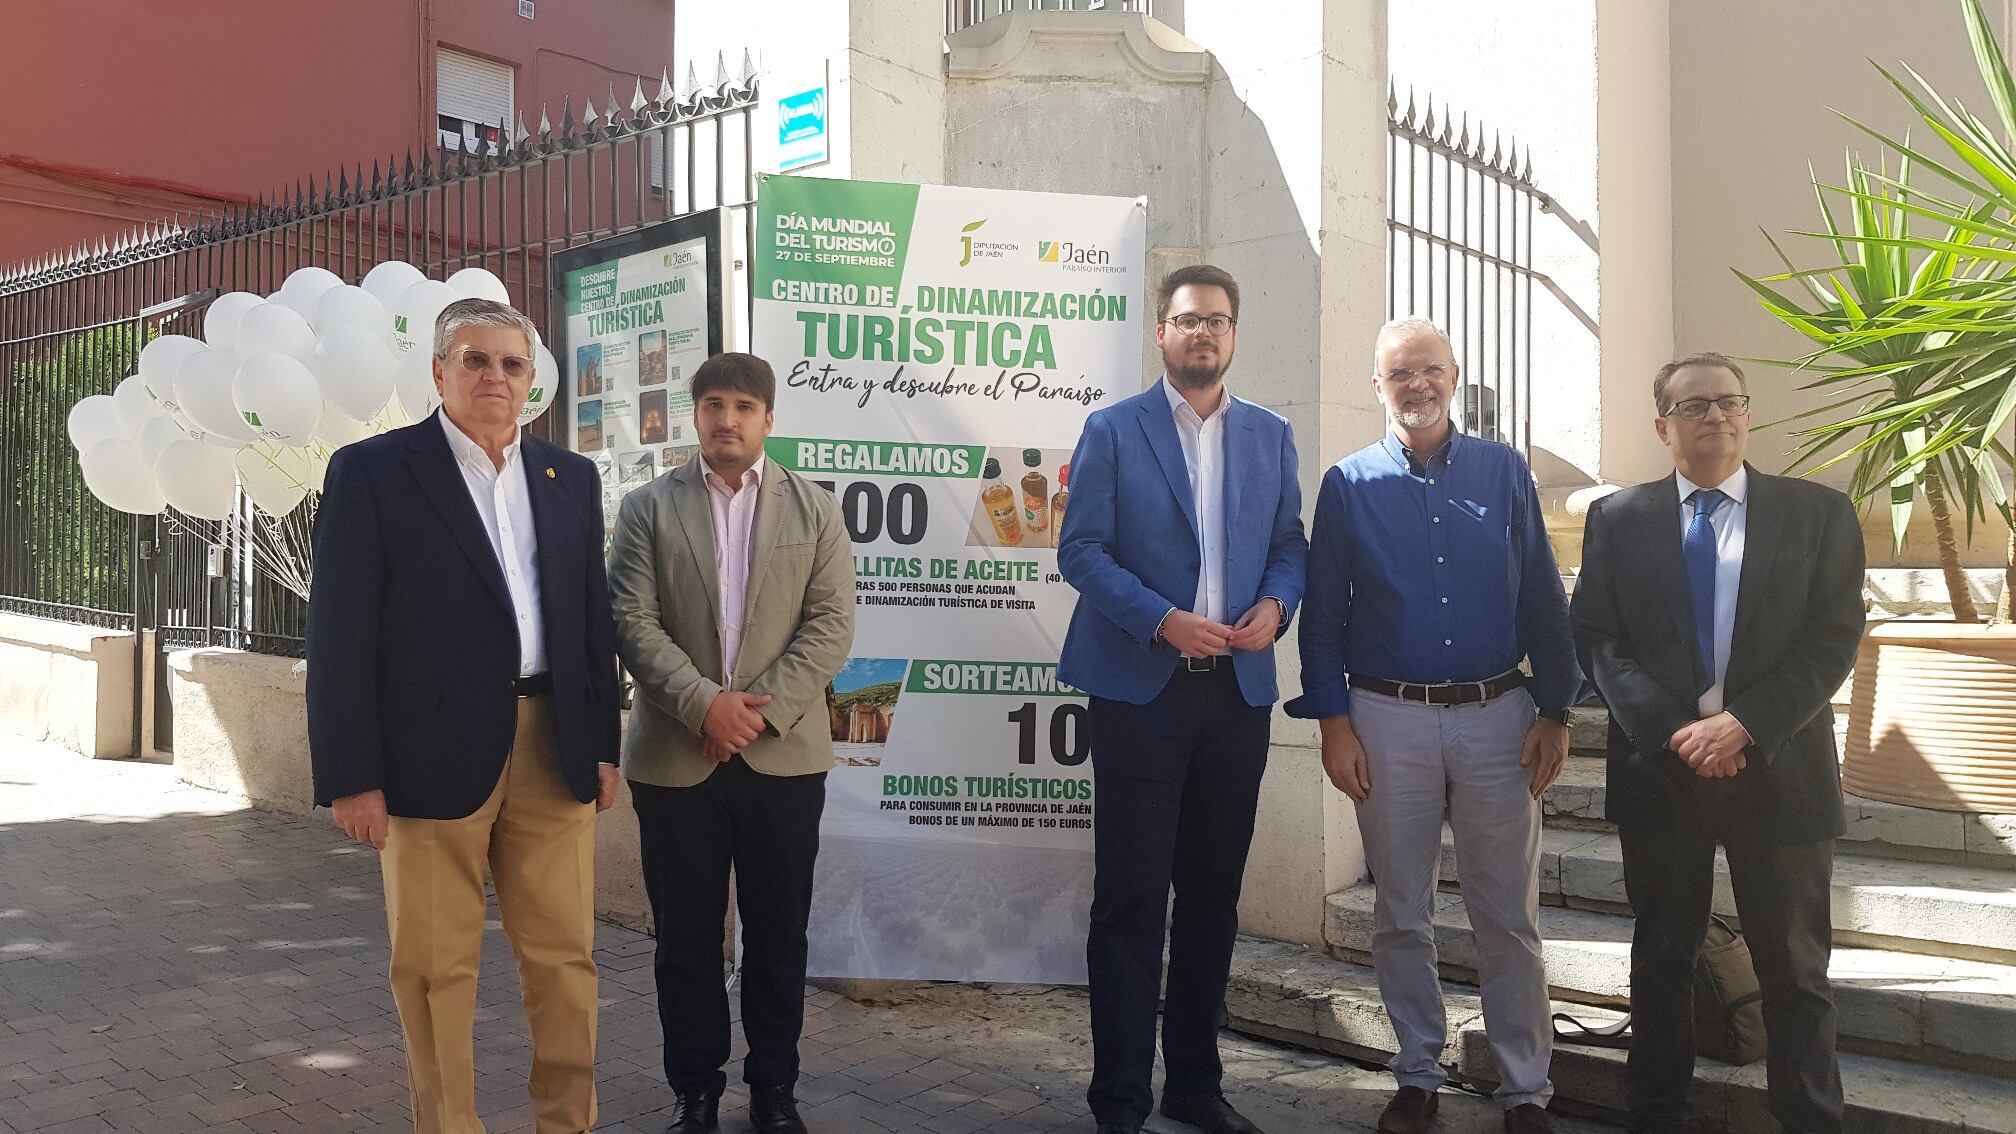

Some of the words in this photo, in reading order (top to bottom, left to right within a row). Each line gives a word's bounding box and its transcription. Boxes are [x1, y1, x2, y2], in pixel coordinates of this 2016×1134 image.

[776, 212, 809, 231] DÍA
[811, 216, 896, 237] MUNDIAL
[775, 232, 811, 249] DEL
[812, 234, 896, 256] TURISMO
[973, 242, 1019, 251] DIPUTACIÓN
[985, 250, 1004, 258] JAÉN
[1062, 242, 1109, 265] Jaén
[672, 250, 692, 265] Jaén
[776, 251, 791, 260] 27
[794, 251, 812, 262] DE
[815, 253, 895, 267] SEPTIEMBRE
[1062, 264, 1093, 273] PARAÍSO
[1093, 266, 1127, 274] INTERIOR
[580, 268, 616, 287] DESCUBRE
[580, 284, 611, 301] NUESTRO
[580, 299, 605, 313] CENTRO
[605, 296, 615, 308] DE
[620, 276, 686, 306] DINAMIZACIÓN
[772, 279, 859, 305] CENTRO
[865, 285, 894, 307] DE
[917, 284, 1127, 322] DINAMIZACIÓN
[587, 300, 664, 338] TURÍSTICA
[796, 305, 1057, 370] TURÍSTICA
[787, 360, 858, 393] Entra
[857, 381, 879, 408] y
[883, 364, 981, 399] descubre
[983, 369, 1007, 401] el
[1010, 372, 1106, 406] Paraíso
[797, 442, 970, 475] REGALAMOS
[812, 480, 929, 545] 00
[930, 558, 958, 579] DE
[963, 559, 1039, 581] ACEITE
[878, 582, 897, 592] 500
[900, 582, 952, 593] PERSONAS
[954, 584, 974, 595] QUE
[975, 585, 1016, 595] ACUDAN
[865, 595, 936, 607] DINAMIZACIÓN
[938, 596, 988, 608] TURÍSTICA
[990, 599, 1004, 609] DE
[1005, 600, 1036, 610] VISITA
[923, 663, 1087, 693] SORTEAM
[1008, 702, 1090, 766] 10
[883, 774, 959, 797] BONOS
[964, 772, 1092, 800] TURÍSTICOS
[880, 800, 907, 810] PARA
[909, 800, 962, 811] CONSUMIR
[964, 801, 978, 812] EN
[980, 802, 993, 812] LA
[995, 802, 1048, 813] PROVINCIA
[1050, 803, 1064, 814] DE
[1066, 802, 1092, 814] JAÉN
[909, 815, 943, 826] BONOS
[945, 816, 959, 826] DE
[961, 816, 975, 826] UN
[978, 814, 1019, 827] MÁXIMO
[1021, 817, 1035, 827] DE
[1038, 818, 1057, 828] 150
[1059, 819, 1092, 829] EUROS
